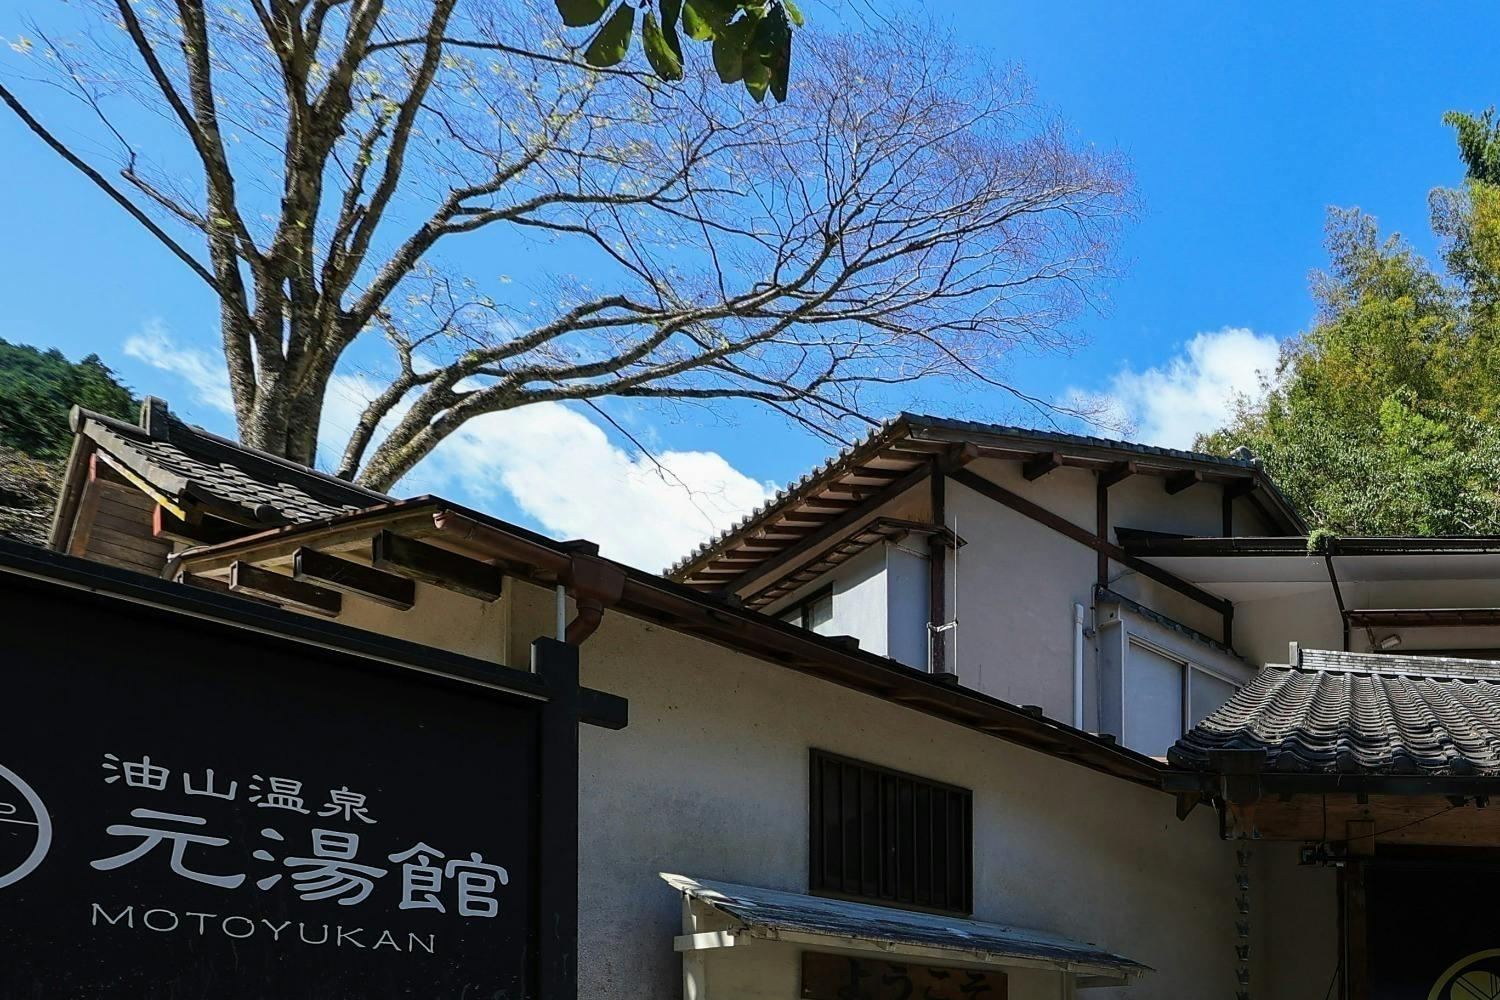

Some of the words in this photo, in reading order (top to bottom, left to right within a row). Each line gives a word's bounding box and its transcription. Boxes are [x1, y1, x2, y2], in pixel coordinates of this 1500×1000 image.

[102, 753, 377, 824] 油山温泉
[90, 808, 509, 918] 元湯館
[91, 903, 436, 954] MOTOYUKAN
